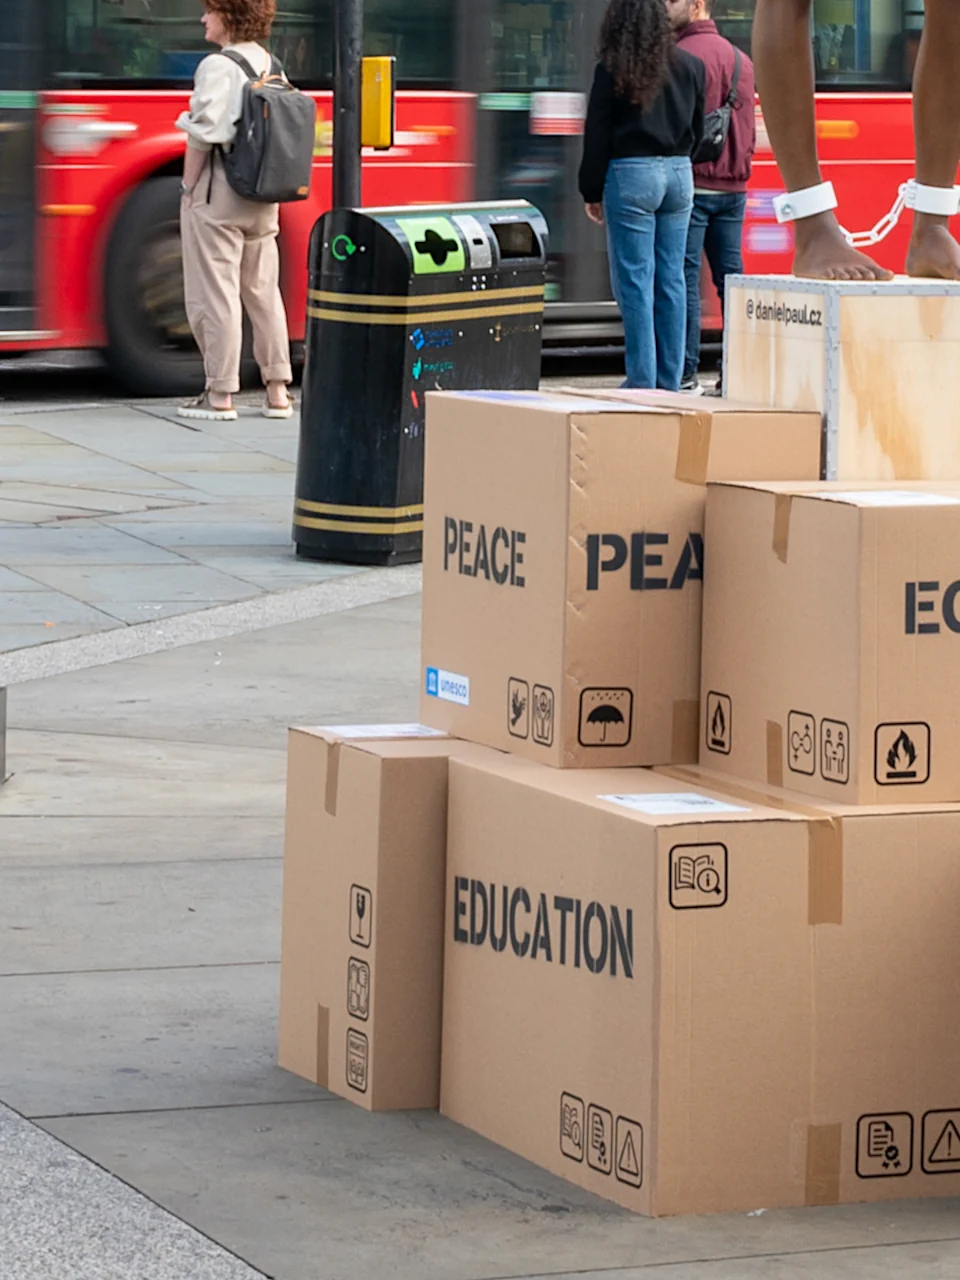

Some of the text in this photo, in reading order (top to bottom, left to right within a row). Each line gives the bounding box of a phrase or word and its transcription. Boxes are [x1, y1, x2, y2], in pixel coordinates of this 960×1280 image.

[444, 516, 526, 588] PEACE
[586, 532, 704, 591] PEA
[441, 677, 468, 699] unesco
[454, 875, 633, 979] EDUCATION
